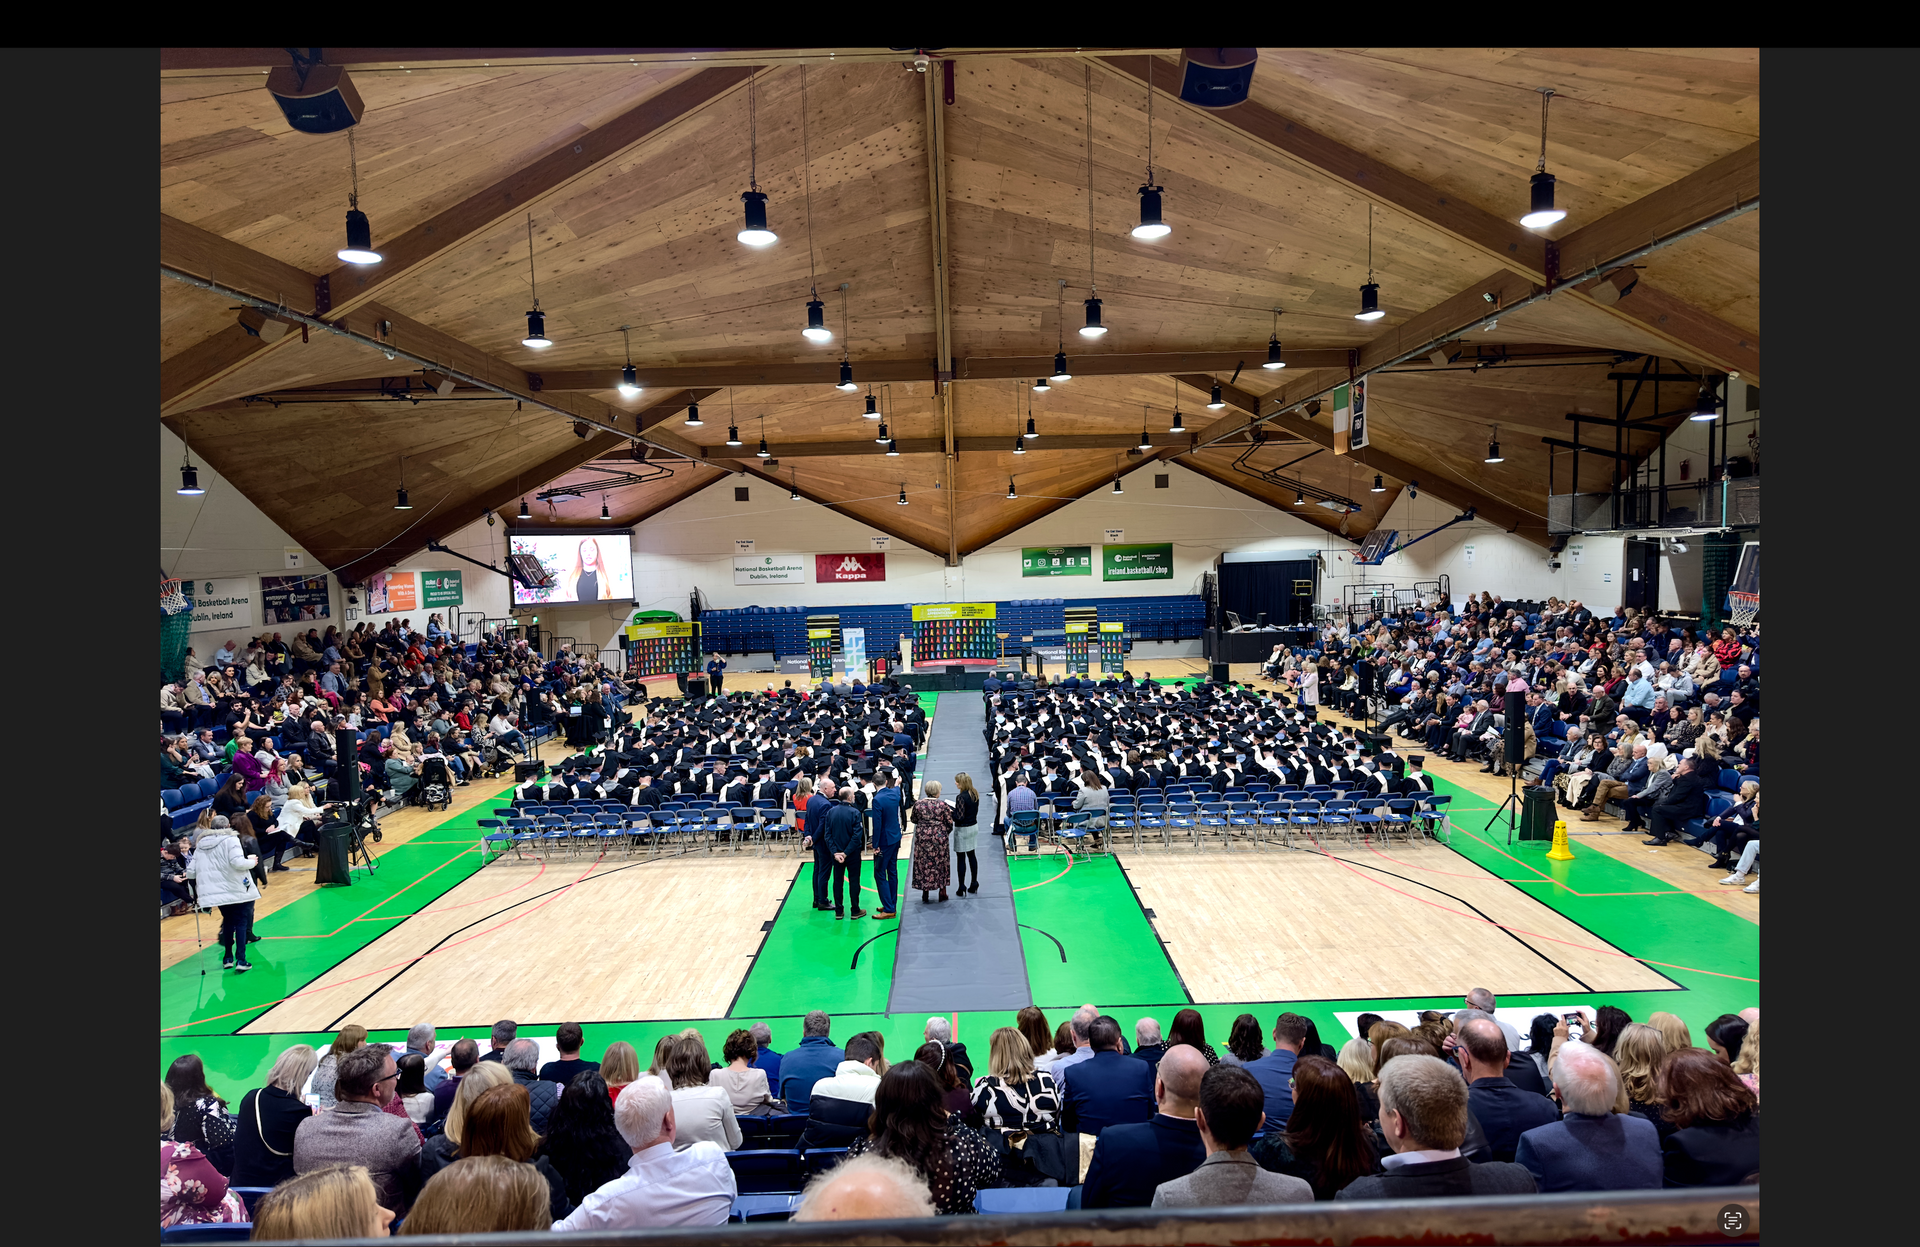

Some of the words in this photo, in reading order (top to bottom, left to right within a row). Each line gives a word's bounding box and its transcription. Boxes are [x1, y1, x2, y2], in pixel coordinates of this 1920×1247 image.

[1108, 566, 1168, 575] ireland.basketball/shop
[198, 598, 231, 607] Basketball
[212, 611, 233, 620] Ireland
